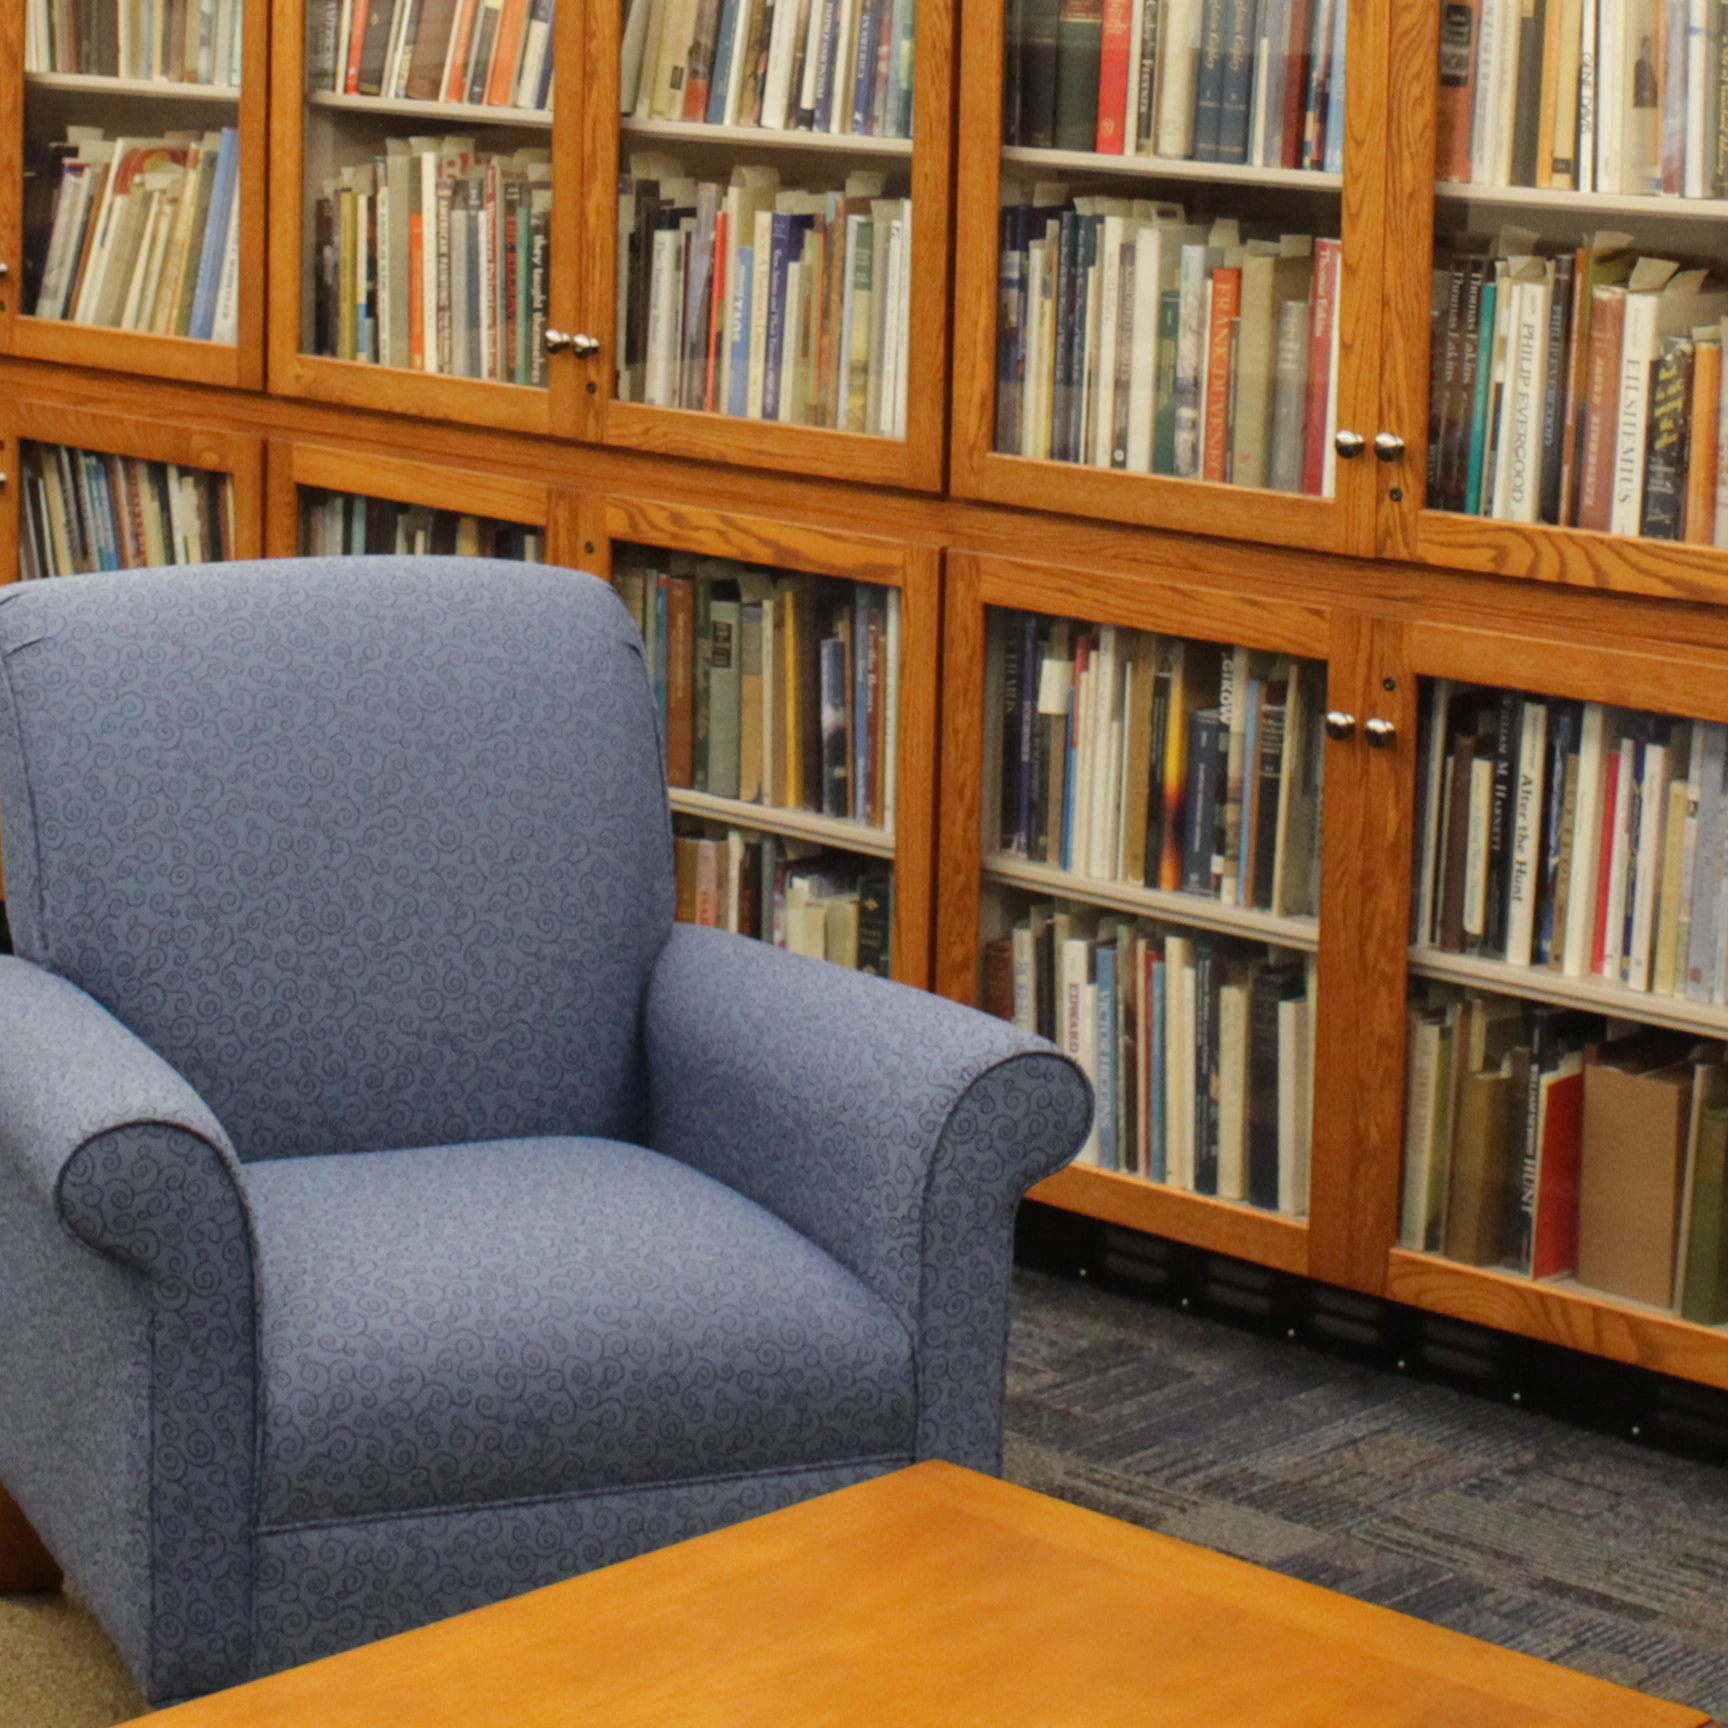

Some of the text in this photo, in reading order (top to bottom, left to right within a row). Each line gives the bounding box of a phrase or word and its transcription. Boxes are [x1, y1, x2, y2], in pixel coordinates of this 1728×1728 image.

[815, 2, 833, 99] IMPRESSIONISM
[1206, 33, 1220, 69] Copley
[1228, 35, 1245, 71] Copley
[1580, 53, 1593, 135] GENE DAVIS
[438, 199, 448, 307] AMERICAN PAINTING
[1315, 248, 1331, 338] Thomas Eakins
[531, 235, 546, 383] they taught themselves
[732, 299, 743, 343] TAOS
[1212, 283, 1233, 360] FRANK
[1445, 272, 1464, 382] Thomas Eakins
[1462, 273, 1483, 384] Thomas Eakins
[1511, 323, 1535, 503] PHILIP EVERGOOD
[1618, 358, 1642, 504] EILSHEMIUS
[1491, 784, 1508, 851] HARNETT
[1512, 774, 1535, 904] After the Hunt
[1068, 983, 1079, 1054] EDWARD
[1098, 990, 1111, 1129] VICTOR HIGGINS
[1520, 1157, 1536, 1216] HUNT
